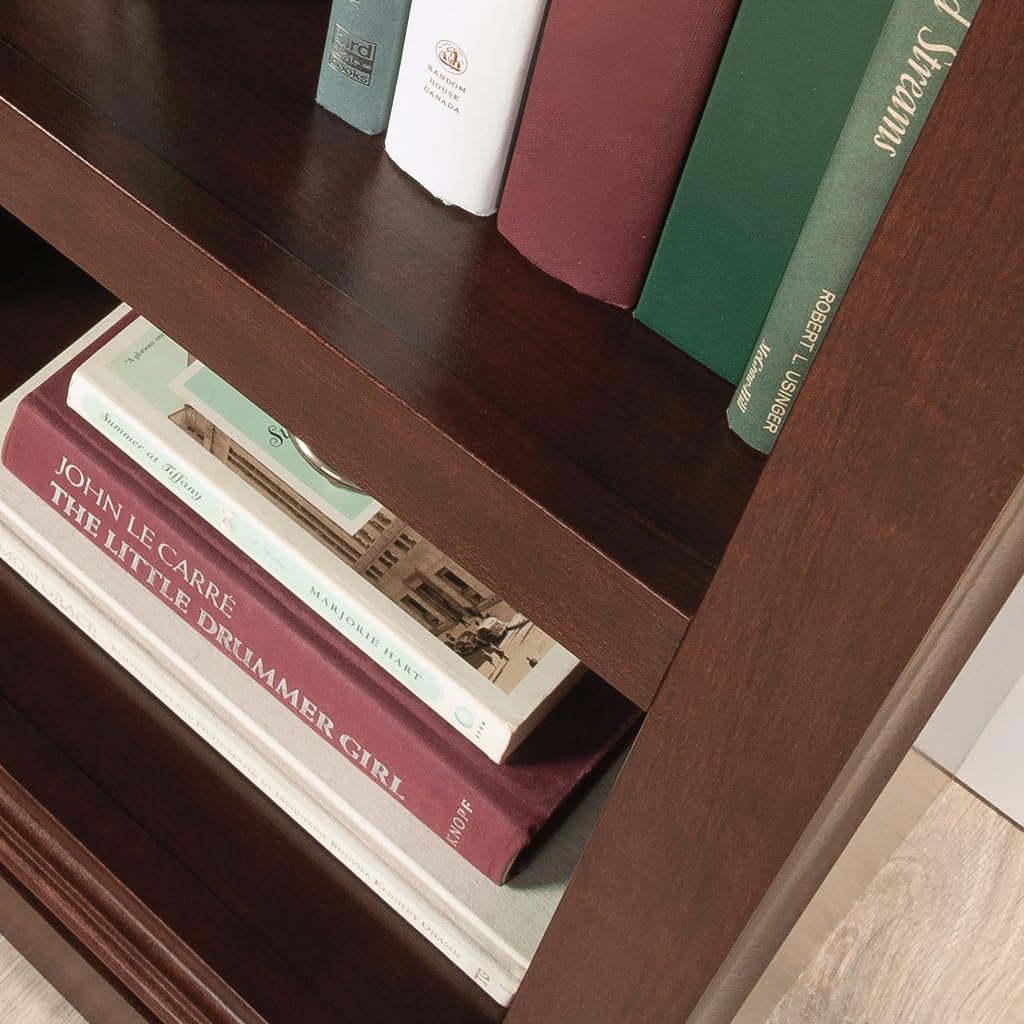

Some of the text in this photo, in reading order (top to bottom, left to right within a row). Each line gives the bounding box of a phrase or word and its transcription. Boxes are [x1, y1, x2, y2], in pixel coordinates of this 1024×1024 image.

[424, 86, 460, 113] CANADA
[427, 64, 467, 93] RANDOM
[429, 78, 460, 101] HOUSE
[874, 26, 957, 157] Streams
[763, 289, 837, 434] ROBERT L. USINGER
[102, 412, 203, 501] Summer at Tiffany
[55, 456, 123, 521] JOHN
[127, 514, 156, 550] LE
[158, 543, 237, 619] CARRÉ
[50, 480, 102, 538] THE
[104, 529, 192, 614] LITTLE
[196, 608, 336, 740] DRUMMER
[339, 734, 406, 801] GIRL
[310, 586, 422, 680] MARJORIE HART
[445, 798, 473, 848] KNOPF
